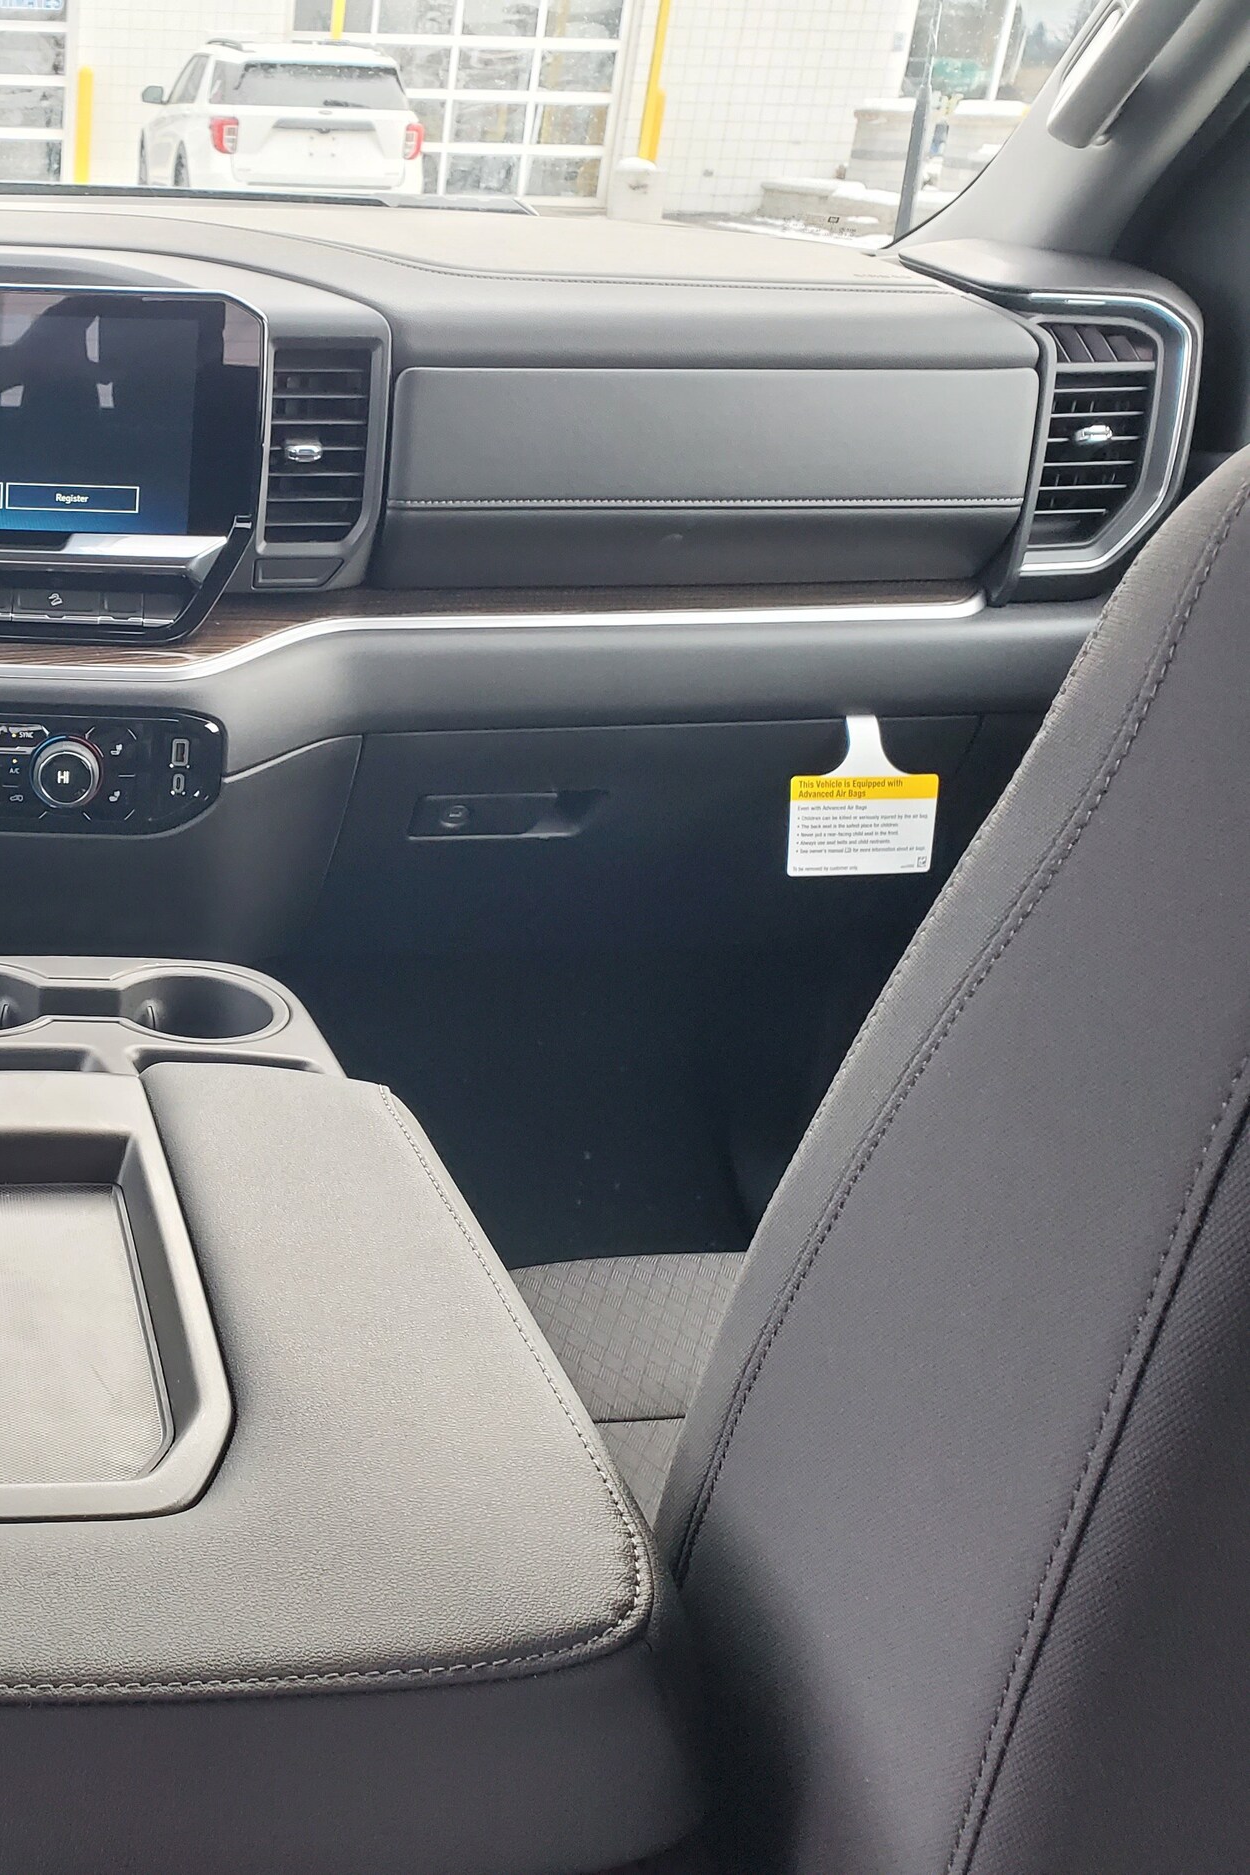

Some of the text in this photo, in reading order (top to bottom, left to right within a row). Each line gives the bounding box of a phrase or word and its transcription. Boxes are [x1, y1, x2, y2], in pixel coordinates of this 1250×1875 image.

[55, 493, 90, 505] Register
[57, 770, 70, 784] HI
[798, 779, 902, 788] This Vehicle is Equipped with
[798, 790, 866, 798] Advanced Air Bags
